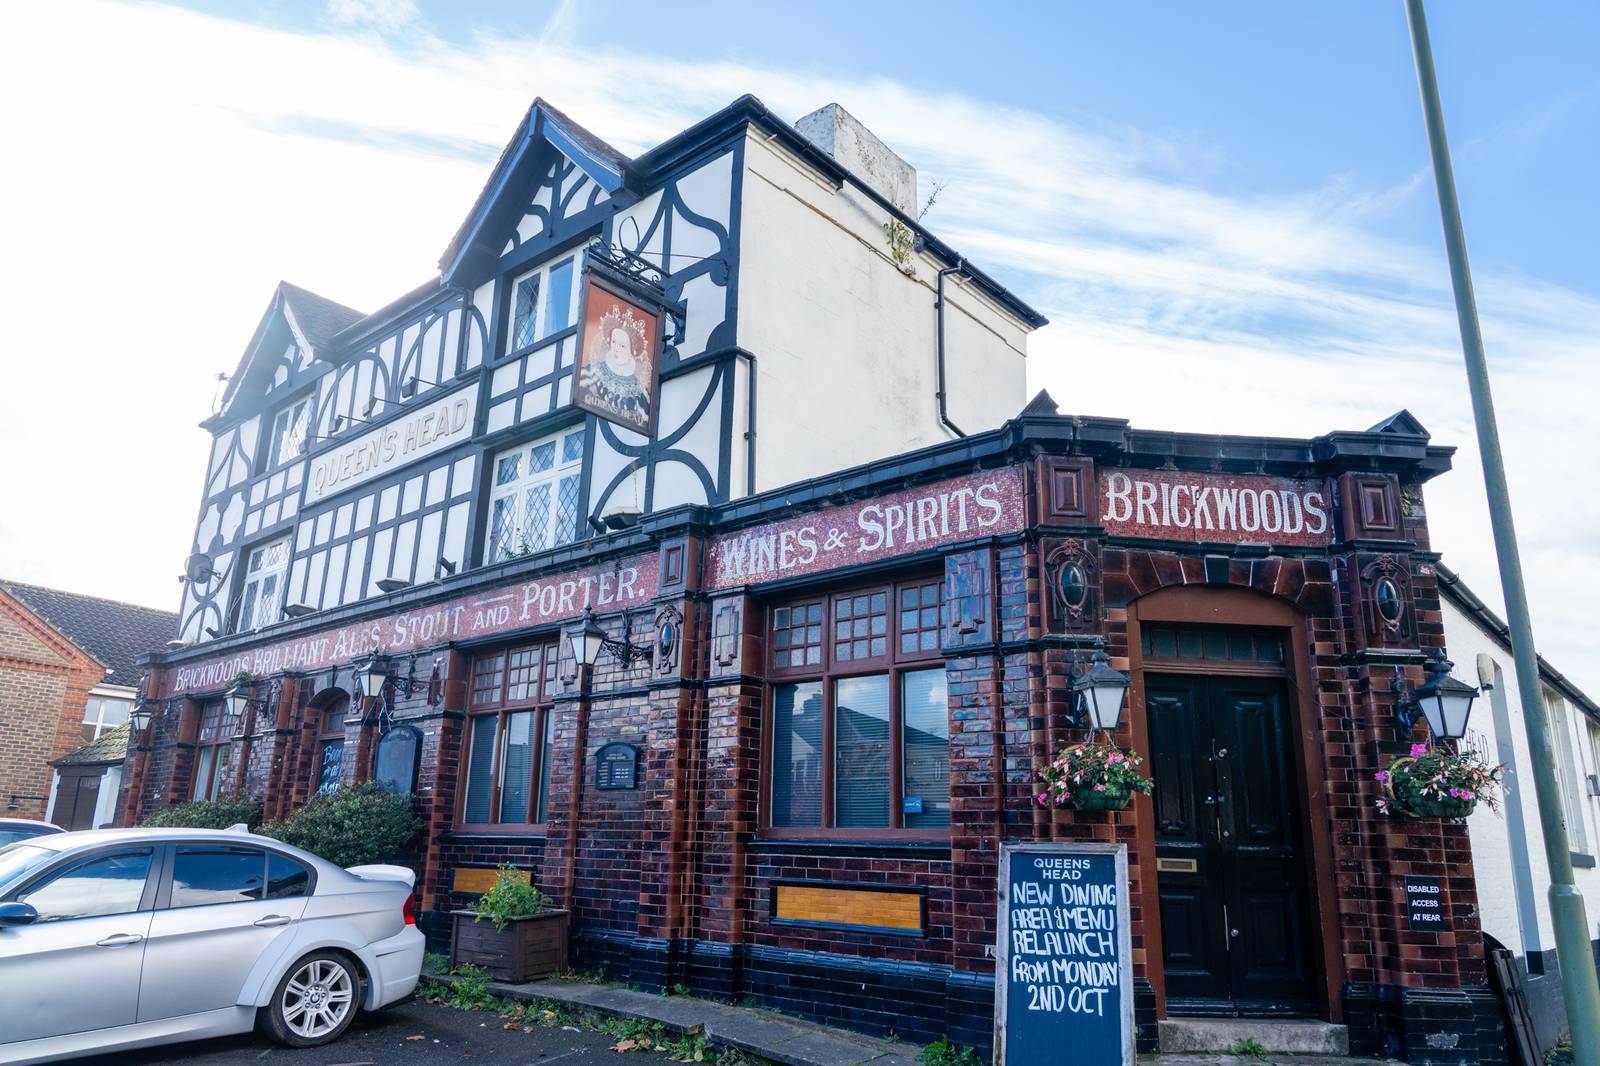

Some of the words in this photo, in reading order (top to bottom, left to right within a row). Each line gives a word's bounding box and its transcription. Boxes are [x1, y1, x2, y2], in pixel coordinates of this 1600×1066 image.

[313, 426, 398, 495] QUEEN'S
[403, 398, 469, 455] HEAD
[1102, 472, 1327, 535] BRICKWOODS
[719, 526, 818, 580] WINES
[823, 528, 849, 551] &
[857, 482, 1002, 553] SPIRITS
[251, 638, 330, 676] BRILLIANT
[389, 606, 464, 647] STOUT
[472, 605, 510, 630] AND
[1033, 858, 1091, 870] QUEENS
[1042, 870, 1082, 880] HEAD
[1013, 881, 1054, 905] NEW
[1060, 882, 1116, 906] DINING
[1407, 885, 1440, 893] DISABLED
[1412, 899, 1439, 907] ACCESS
[1011, 907, 1053, 930] AREA
[1063, 906, 1115, 931] MENU
[1412, 913, 1421, 921] AT
[1422, 913, 1441, 922] REAR
[1012, 929, 1115, 957] RELAUNCH
[1053, 958, 1118, 987] MONDAY
[1027, 985, 1065, 1012] 2ND
[1067, 987, 1109, 1016] OCT
